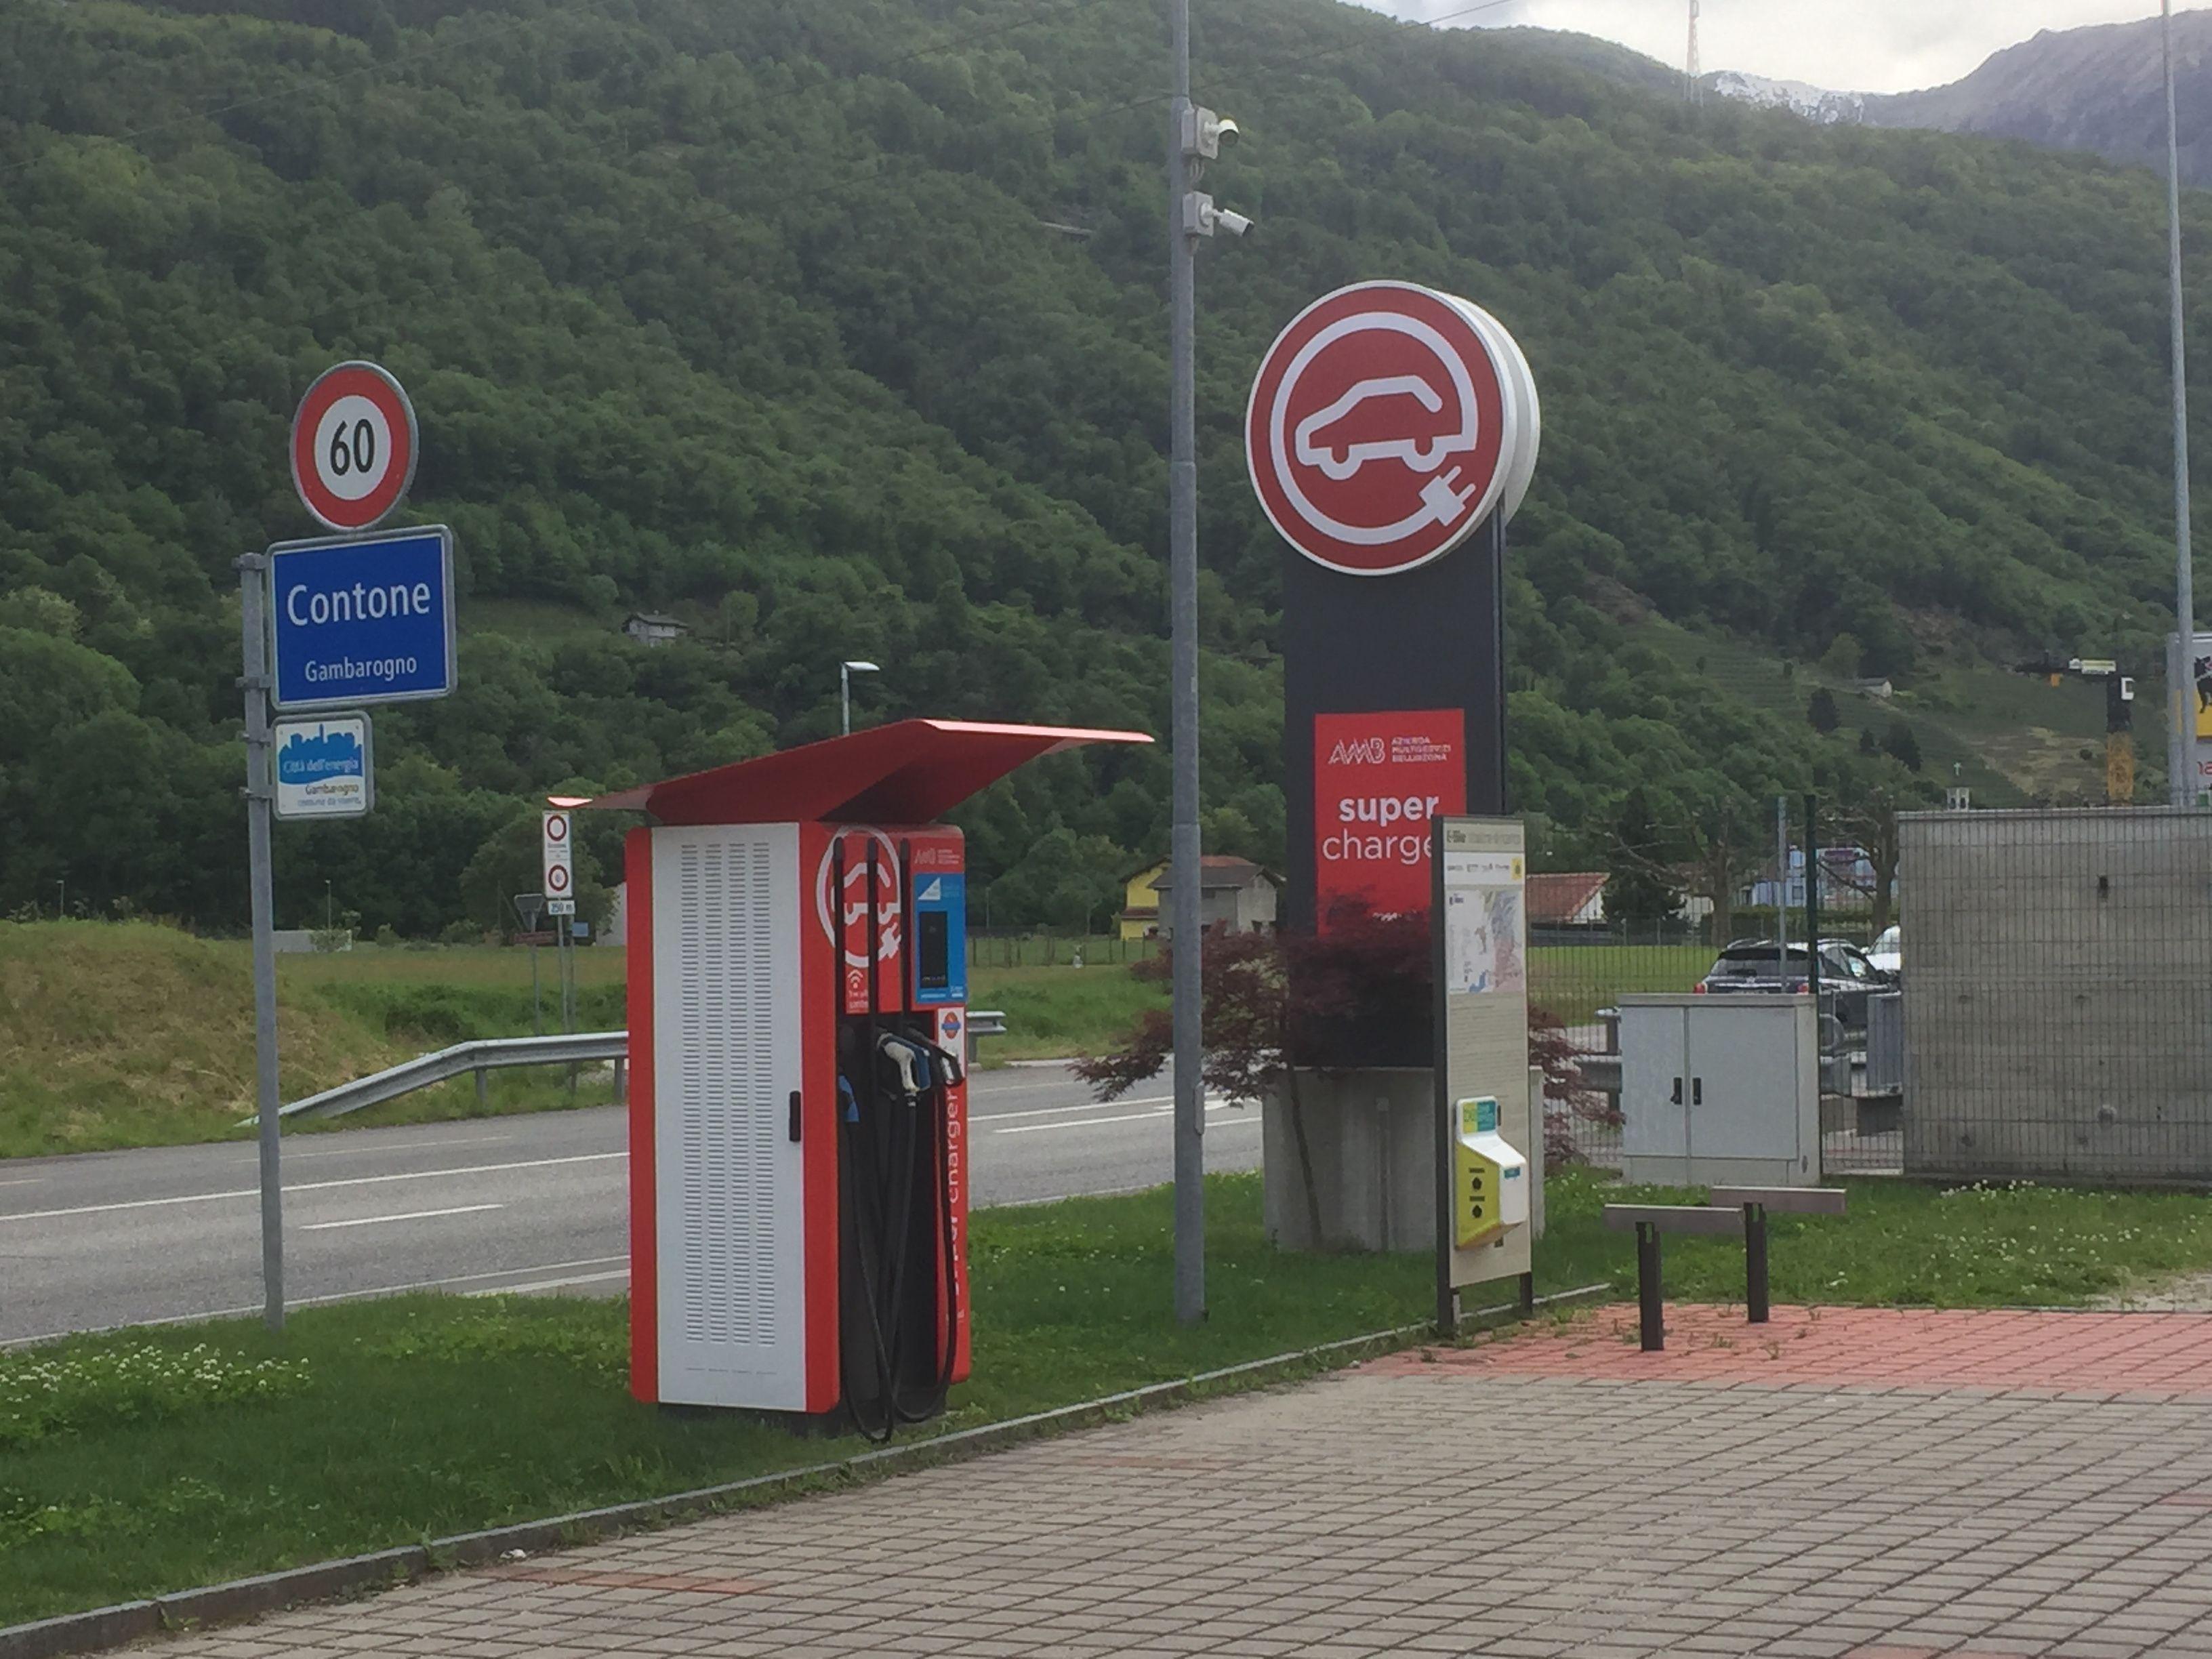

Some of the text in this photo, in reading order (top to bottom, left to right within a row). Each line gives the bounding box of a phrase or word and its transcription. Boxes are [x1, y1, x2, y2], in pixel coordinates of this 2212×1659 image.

[330, 419, 374, 476] 60
[287, 582, 430, 626] Contone
[305, 657, 417, 682] Gambarogno
[1328, 737, 1385, 764] AMB
[1338, 796, 1439, 826] super
